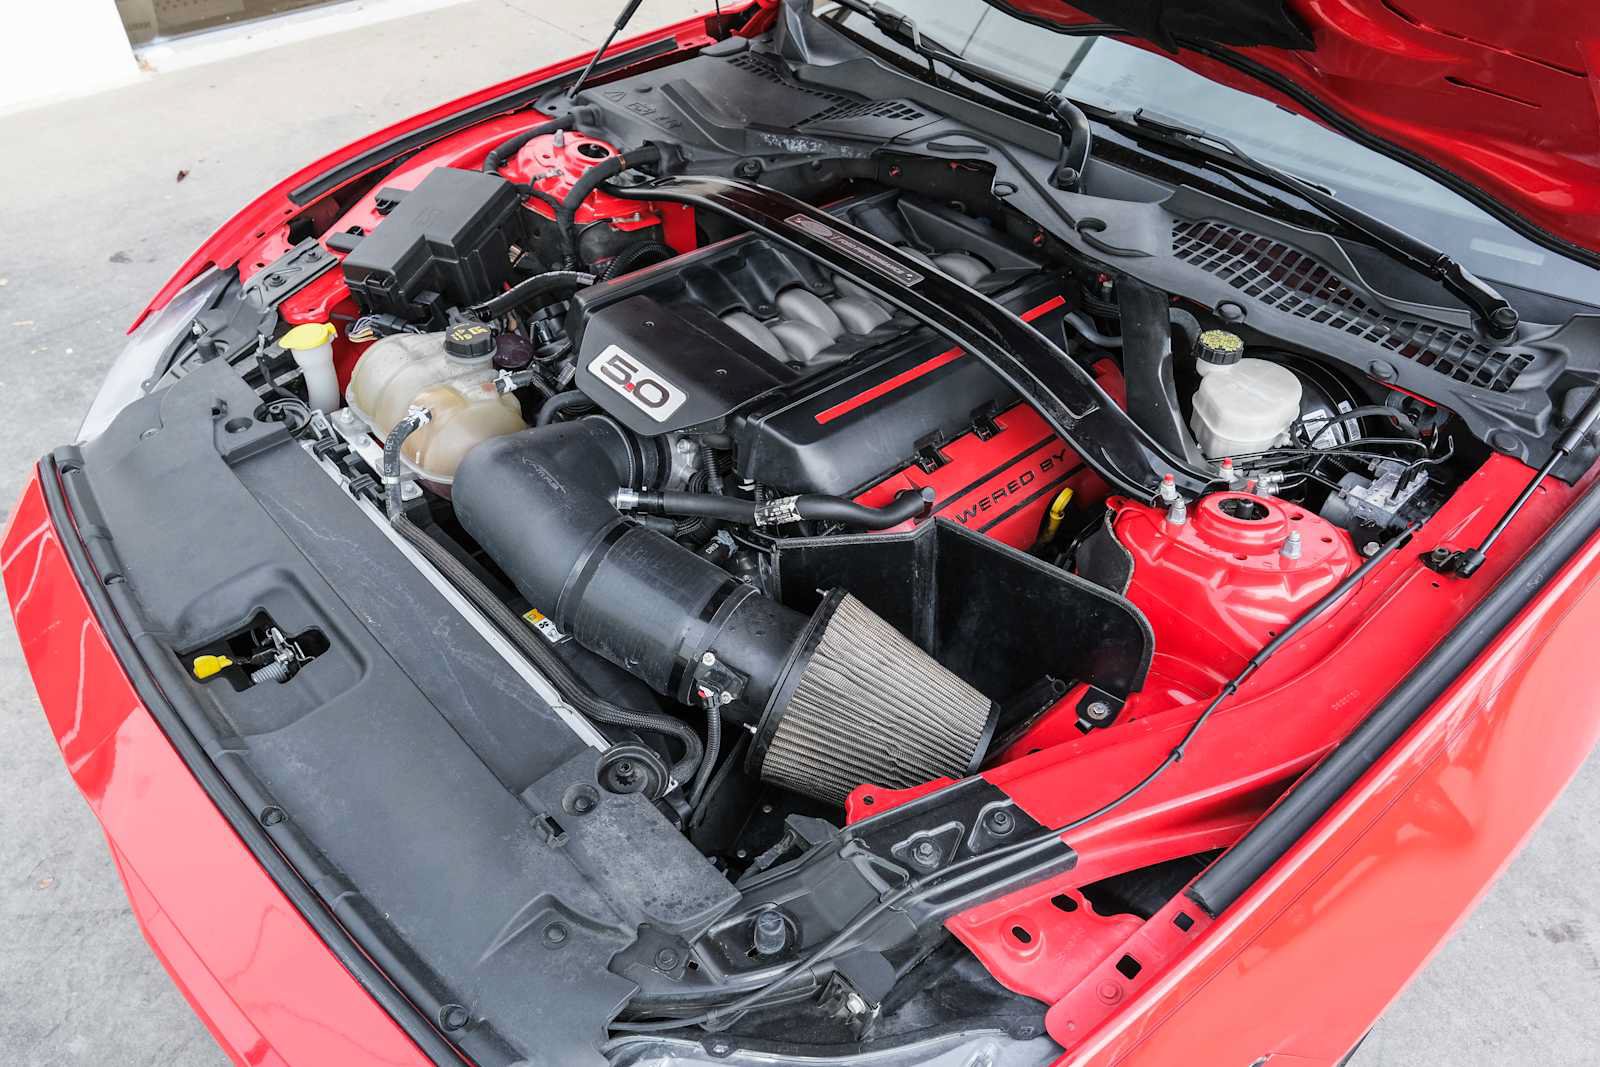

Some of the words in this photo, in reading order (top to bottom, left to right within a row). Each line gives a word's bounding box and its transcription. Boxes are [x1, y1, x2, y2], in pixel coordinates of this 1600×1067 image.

[600, 354, 670, 408] 5.0
[951, 470, 1036, 525] WERED
[1040, 448, 1067, 472] BY
